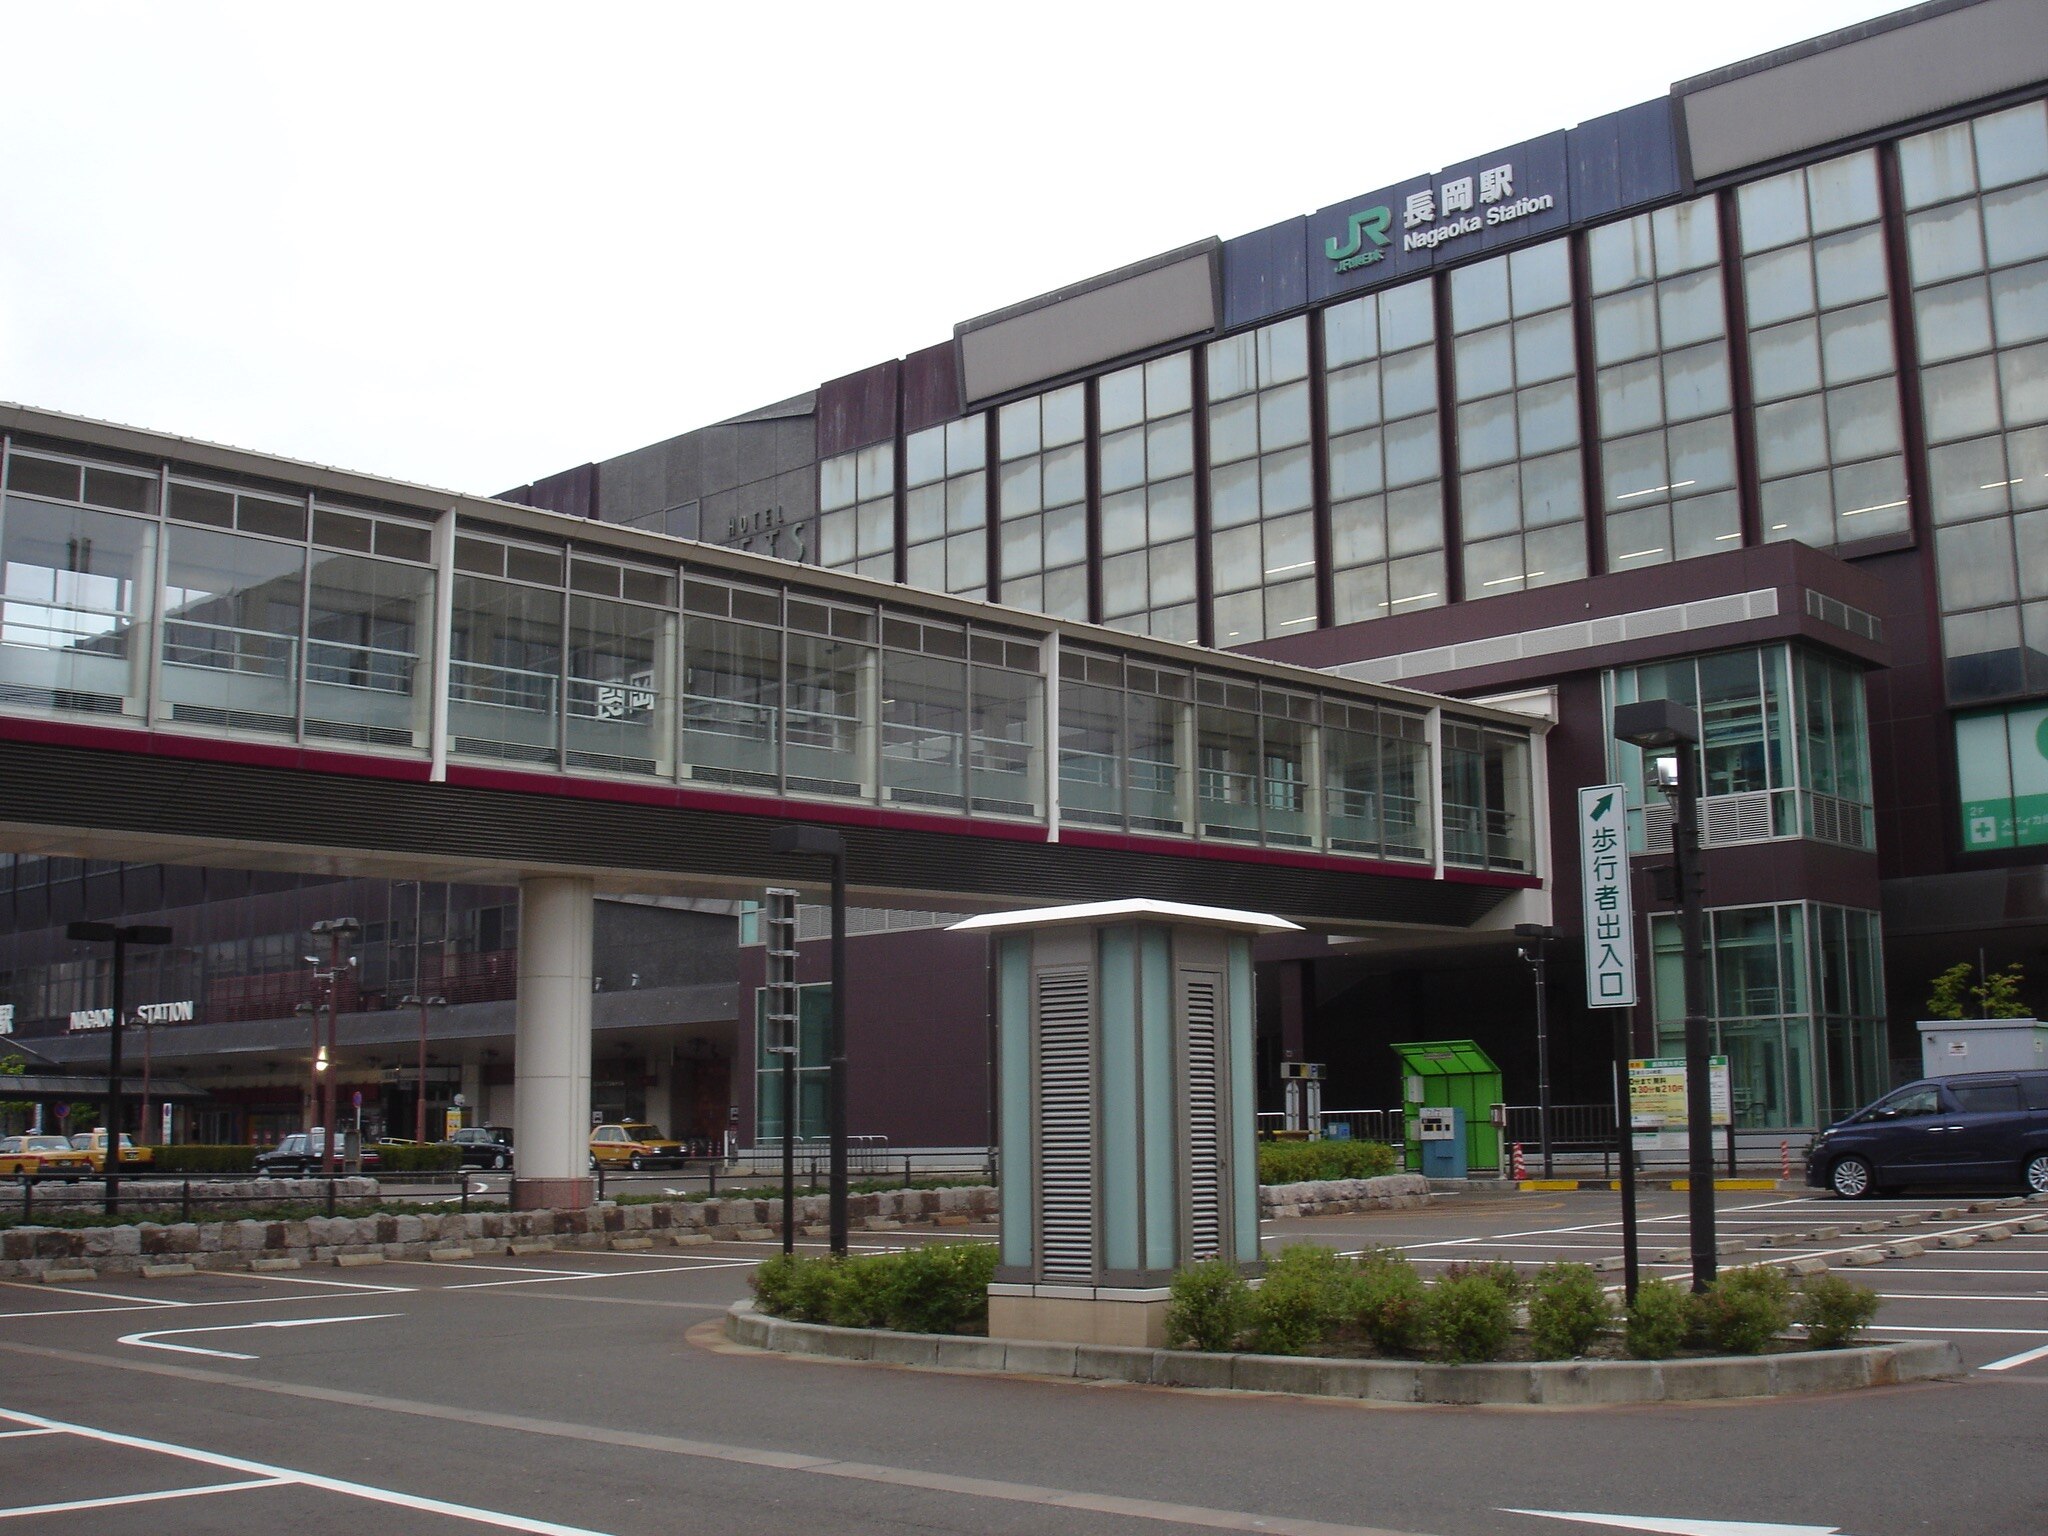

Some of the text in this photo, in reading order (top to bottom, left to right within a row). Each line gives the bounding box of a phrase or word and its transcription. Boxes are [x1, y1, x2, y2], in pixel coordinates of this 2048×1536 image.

[1403, 164, 1514, 229] 長岡駅
[1403, 193, 1554, 253] Nagaoka Station
[1324, 205, 1392, 261] JR
[1592, 826, 1624, 997] 歩行者出入口
[137, 1001, 194, 1023] STATION
